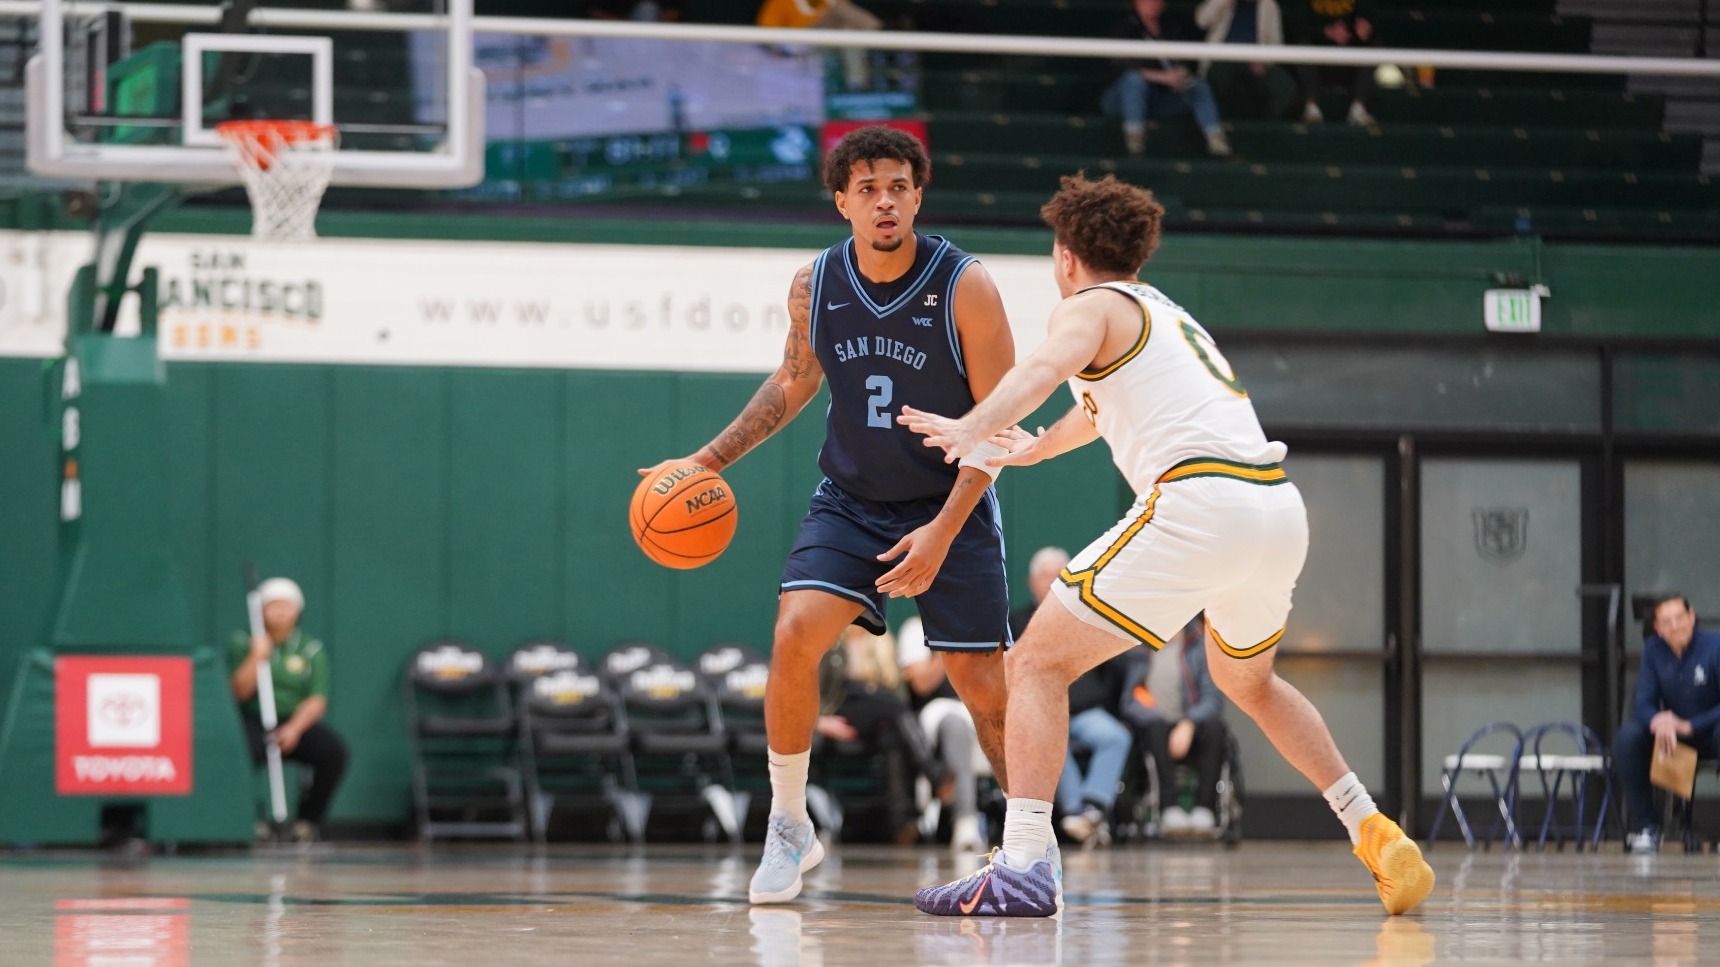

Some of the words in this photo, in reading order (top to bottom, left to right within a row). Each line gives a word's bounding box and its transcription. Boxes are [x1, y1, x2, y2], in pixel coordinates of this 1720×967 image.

[190, 253, 244, 269] SAN
[158, 277, 322, 319] ANCISCO
[417, 291, 788, 333] www.usfdon
[924, 295, 937, 306] JC
[1497, 292, 1531, 323] EXIT
[835, 336, 869, 362] SAN
[875, 336, 927, 370] DIEGO
[865, 374, 893, 429] 2
[685, 486, 727, 514] NCAA
[73, 755, 177, 783] TOYOTA
